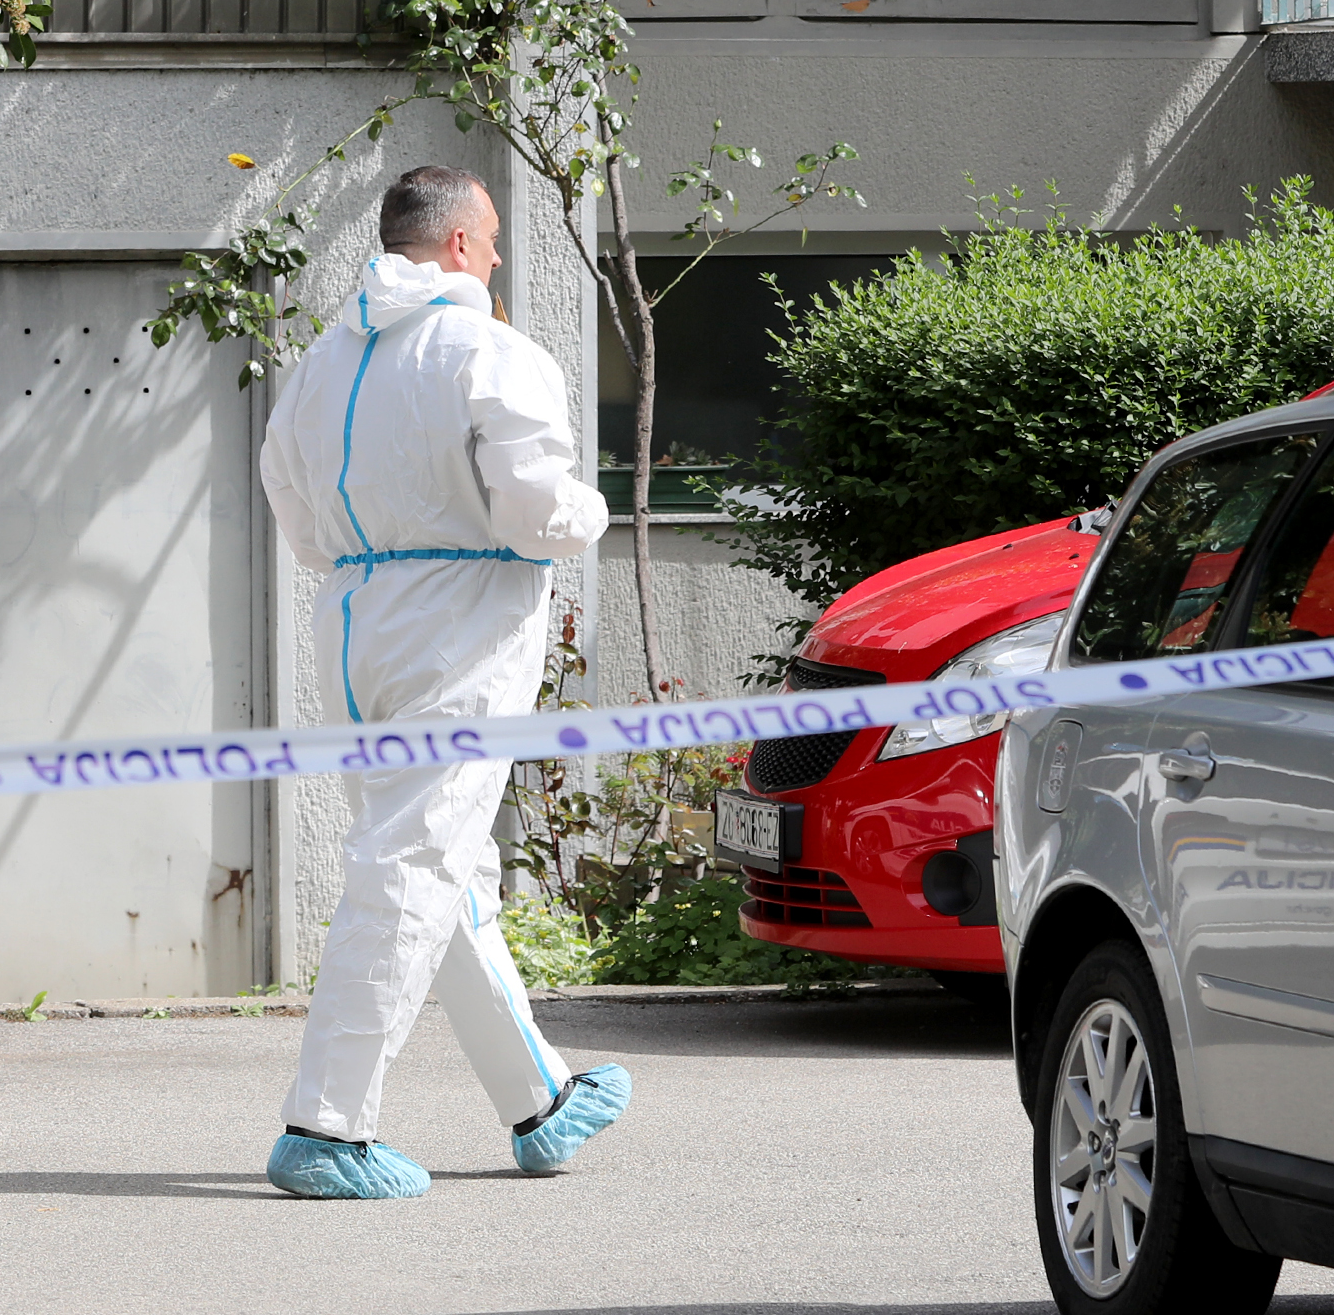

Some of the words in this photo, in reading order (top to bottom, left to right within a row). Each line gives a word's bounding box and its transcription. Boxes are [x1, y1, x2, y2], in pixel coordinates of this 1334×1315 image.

[912, 680, 1055, 719] STOP
[613, 698, 875, 746] POLICIJA
[722, 801, 734, 841] ZG
